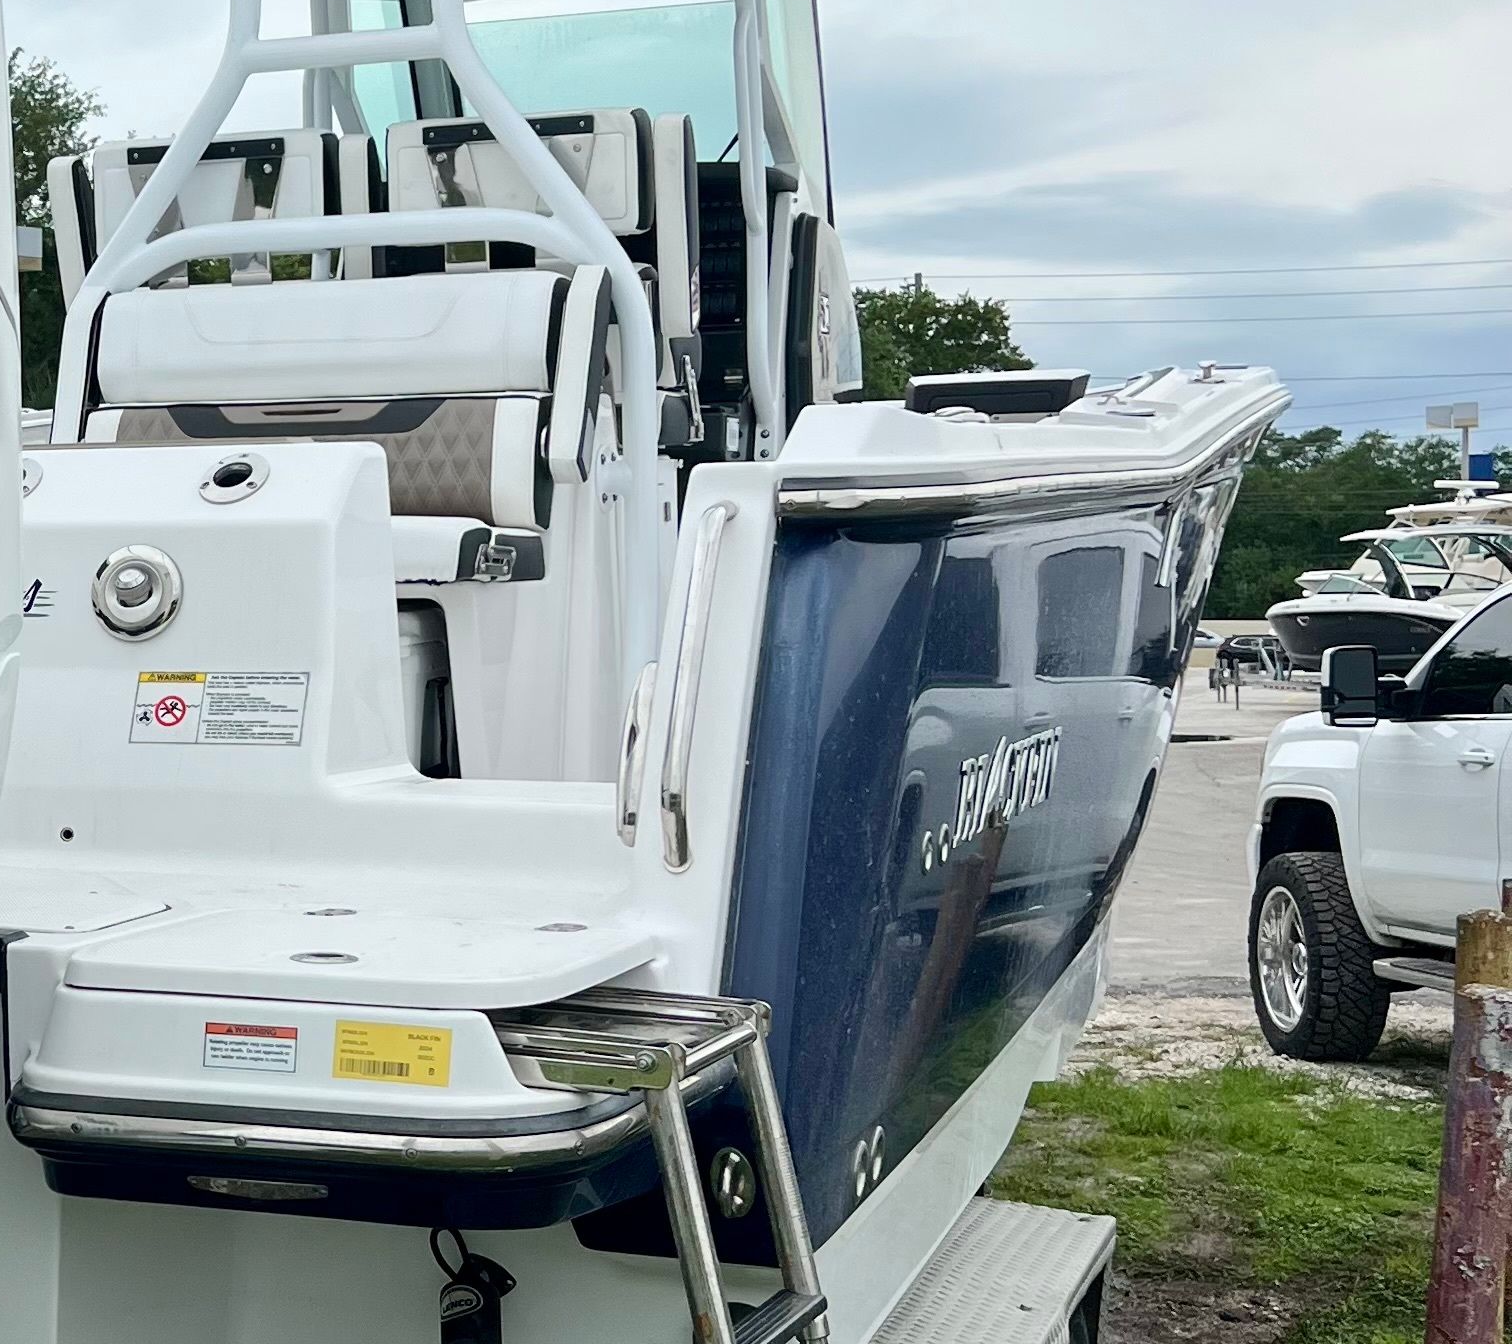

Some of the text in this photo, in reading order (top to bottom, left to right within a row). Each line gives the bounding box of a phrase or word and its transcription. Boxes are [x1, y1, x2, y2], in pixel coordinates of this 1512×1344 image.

[157, 673, 196, 682] WARNING
[234, 1025, 277, 1036] WARNING
[442, 1298, 474, 1314] LENCO
